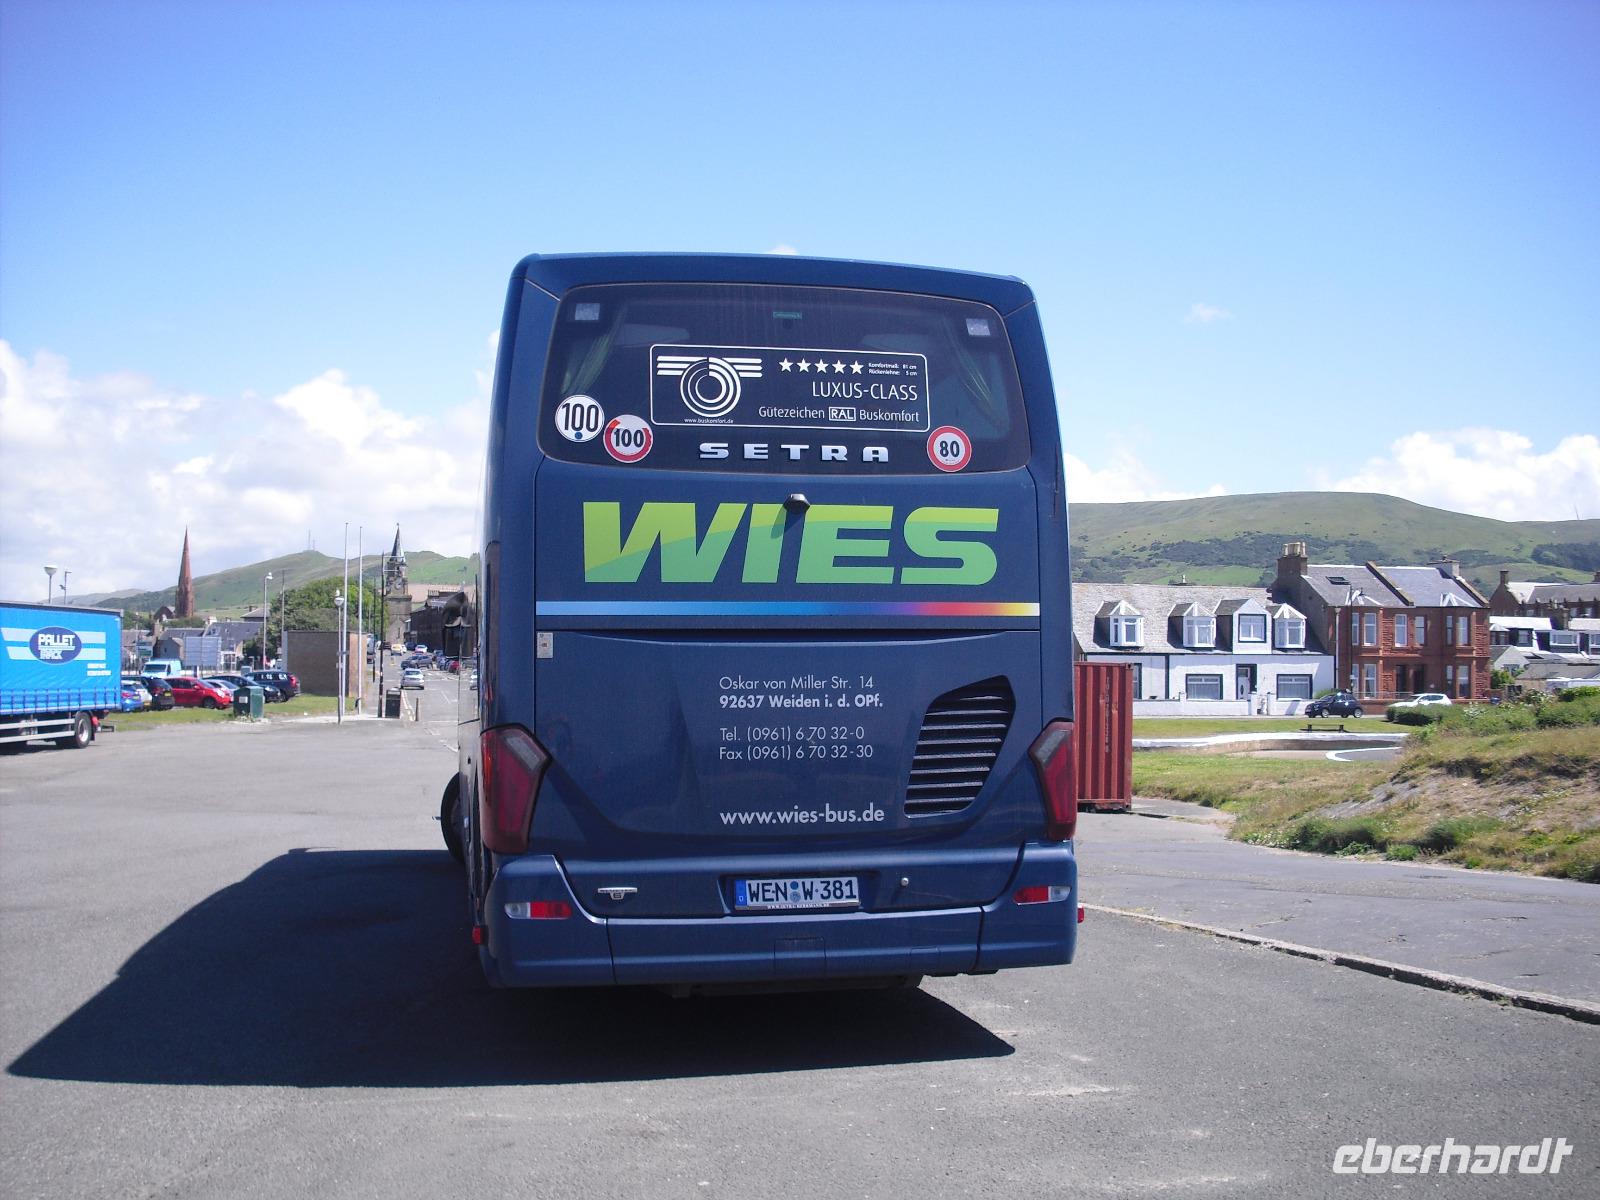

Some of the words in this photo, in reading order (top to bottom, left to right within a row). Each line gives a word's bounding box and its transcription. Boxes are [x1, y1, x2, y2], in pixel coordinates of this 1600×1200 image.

[812, 381, 918, 401] LUXUS-CLASS
[561, 402, 600, 433] 100
[758, 406, 825, 419] Gütezeichen
[831, 408, 854, 420] RAL
[859, 409, 920, 422] Buskomfort
[614, 428, 644, 448] 100
[699, 442, 889, 462] SETRA
[939, 440, 960, 458] 80
[582, 501, 999, 585] WIES
[38, 633, 75, 646] PALLET
[719, 675, 759, 690] Oskar
[763, 680, 786, 689] von
[790, 674, 827, 689] Miller
[831, 676, 852, 689] Str.
[859, 676, 874, 688] 14
[719, 695, 765, 708] 92637
[769, 694, 820, 708] Weiden
[824, 694, 833, 708] i.
[837, 694, 850, 708] d.
[854, 693, 883, 708] OPf.
[720, 727, 741, 741] Tel.
[747, 725, 791, 742] (0961)
[795, 729, 804, 740] 6
[808, 727, 826, 740] 70
[719, 747, 743, 760] Fax
[747, 744, 791, 761] (0961)
[795, 747, 804, 759] 6
[808, 746, 826, 759] 70
[719, 802, 885, 825] www.wies-bus.de
